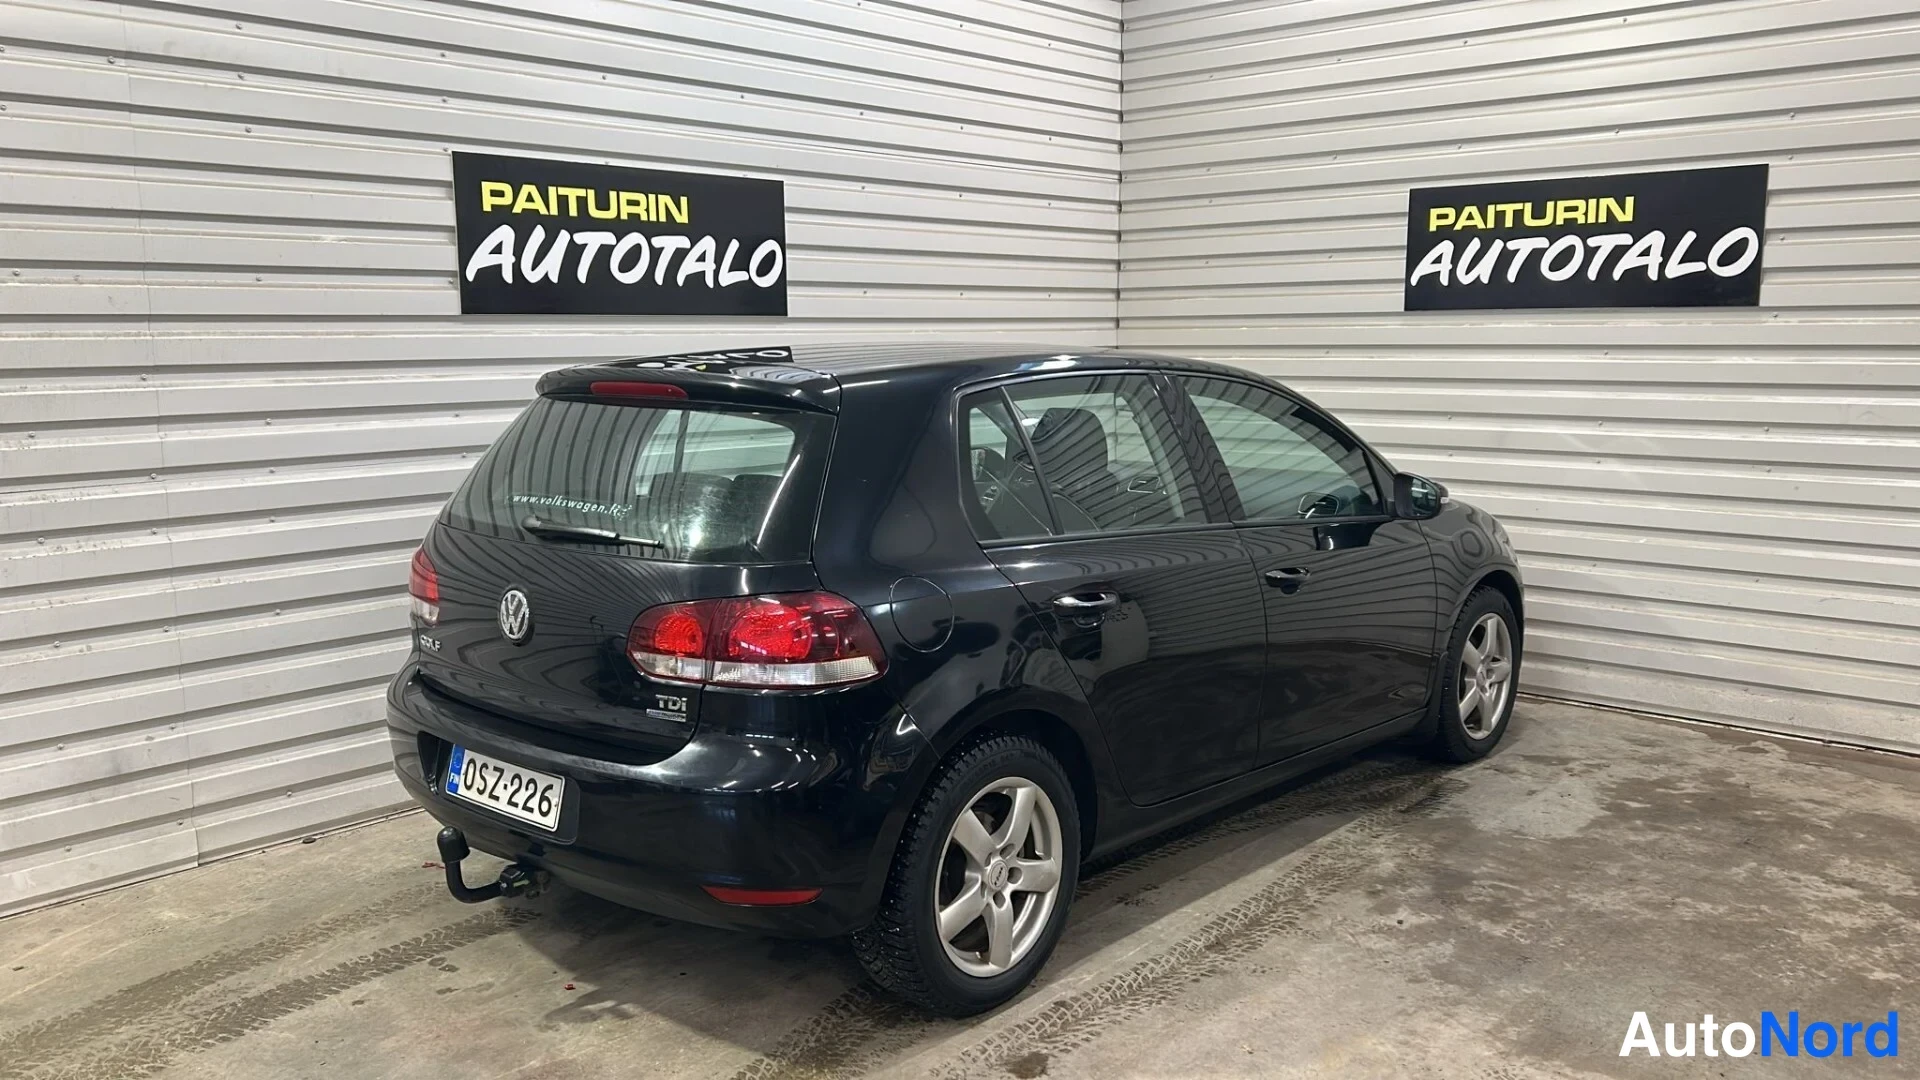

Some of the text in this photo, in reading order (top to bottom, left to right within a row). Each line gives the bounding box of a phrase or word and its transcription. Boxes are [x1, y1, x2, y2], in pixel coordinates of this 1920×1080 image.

[481, 181, 689, 224] PAITURIN
[1429, 196, 1635, 232] PAITURIN
[466, 224, 784, 289] AUTOTALO
[1410, 226, 1760, 288] AUTOTALO
[420, 634, 442, 653] GOLF
[463, 757, 554, 818] OSZ-226
